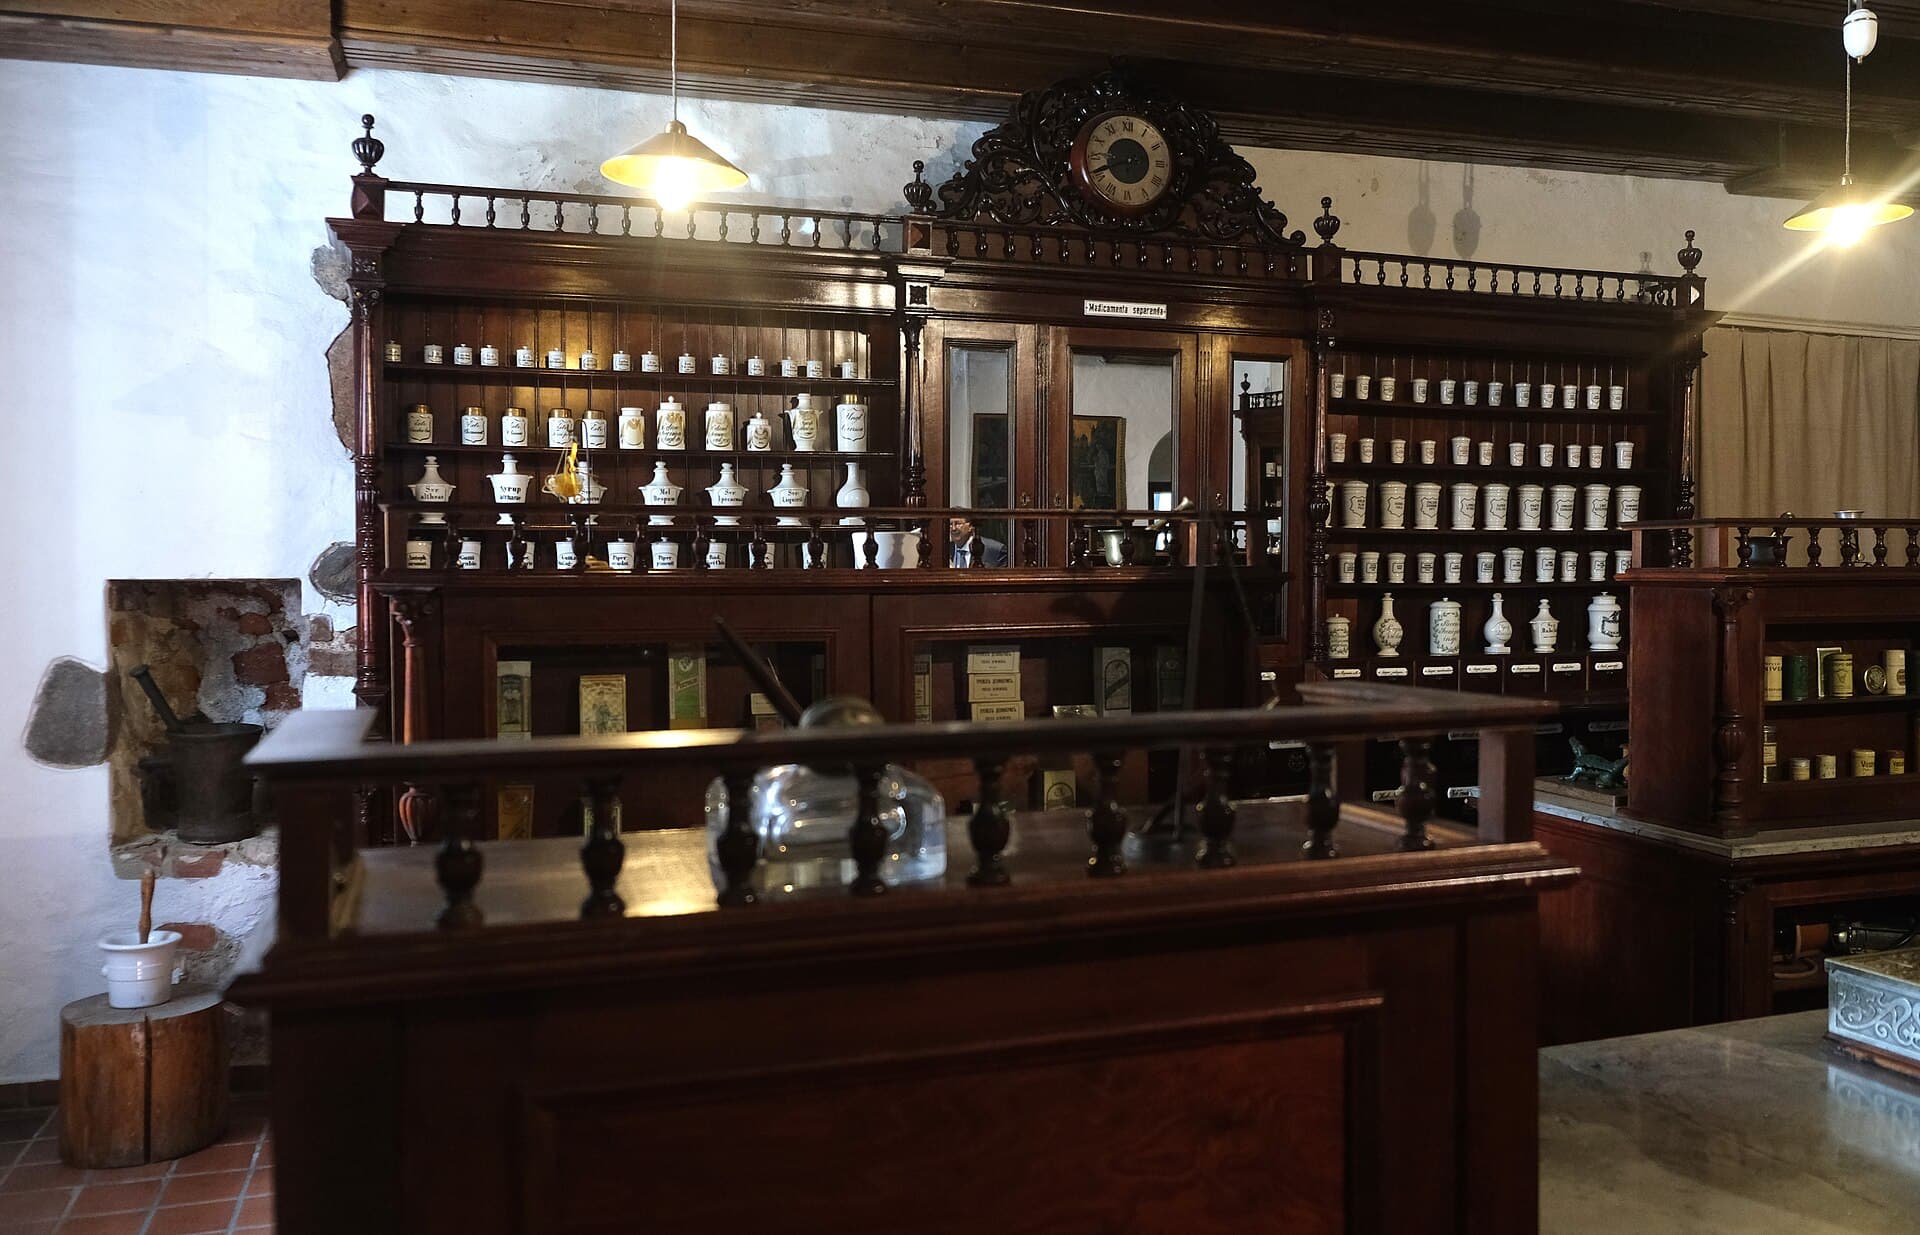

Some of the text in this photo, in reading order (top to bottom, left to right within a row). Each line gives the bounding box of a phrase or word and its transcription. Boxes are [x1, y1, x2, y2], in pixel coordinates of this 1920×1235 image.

[1105, 123, 1116, 136] XI
[1122, 120, 1134, 132] XII
[1151, 143, 1161, 151] II
[1155, 160, 1165, 168] III
